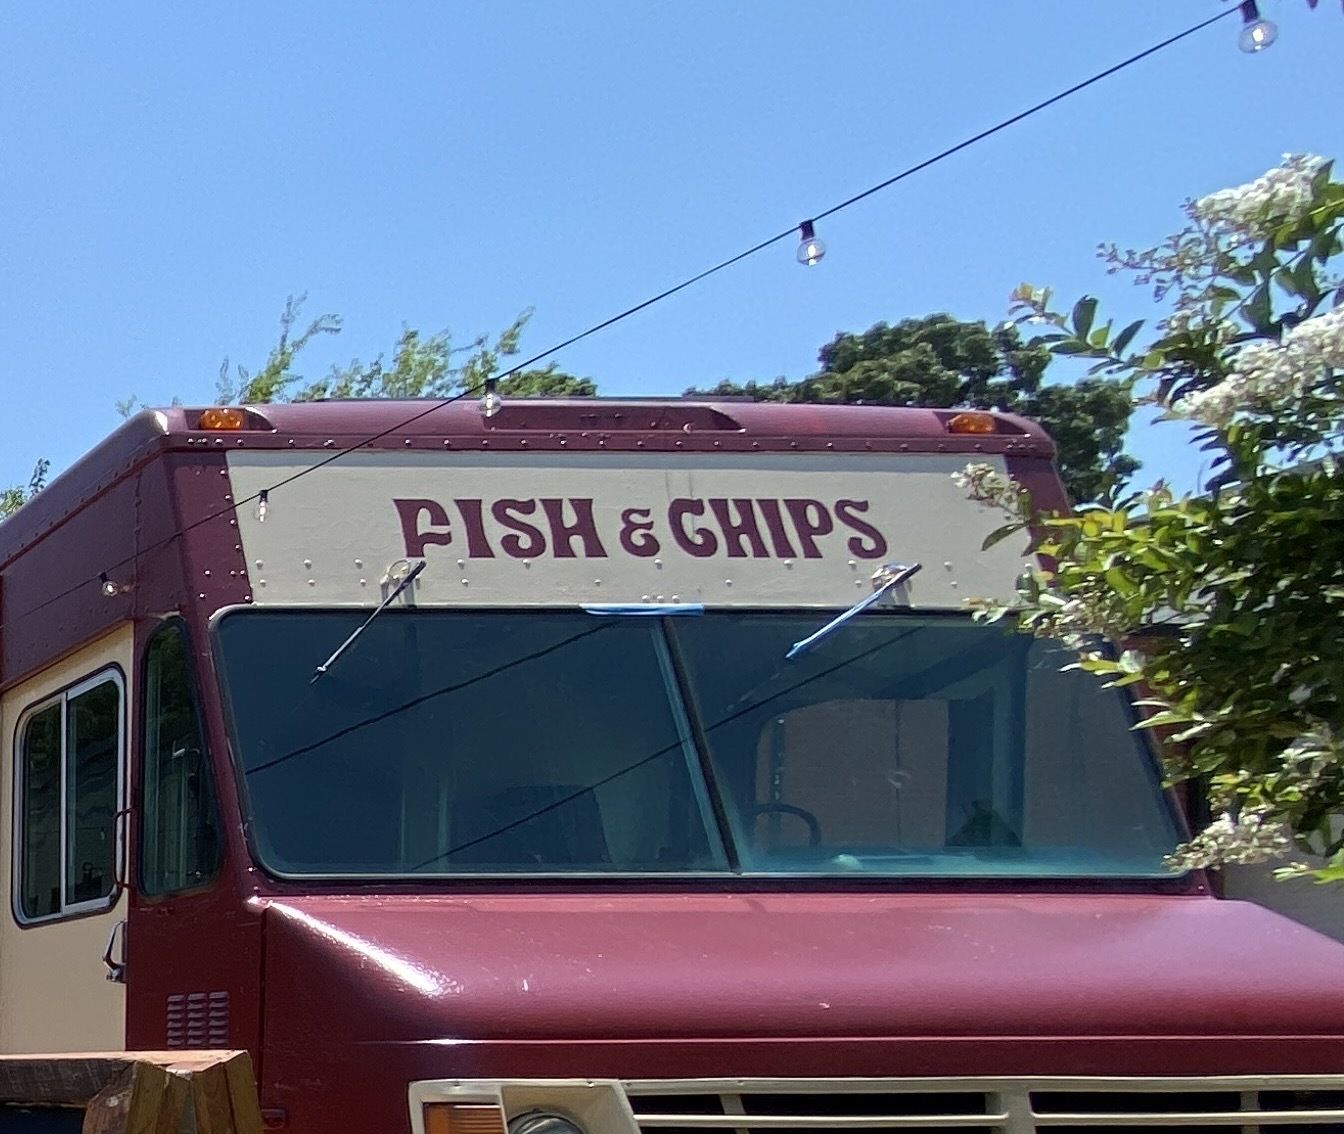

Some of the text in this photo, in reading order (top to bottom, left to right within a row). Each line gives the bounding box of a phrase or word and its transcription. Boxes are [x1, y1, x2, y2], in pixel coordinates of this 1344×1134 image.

[393, 497, 888, 559] FISH & CHIPS
